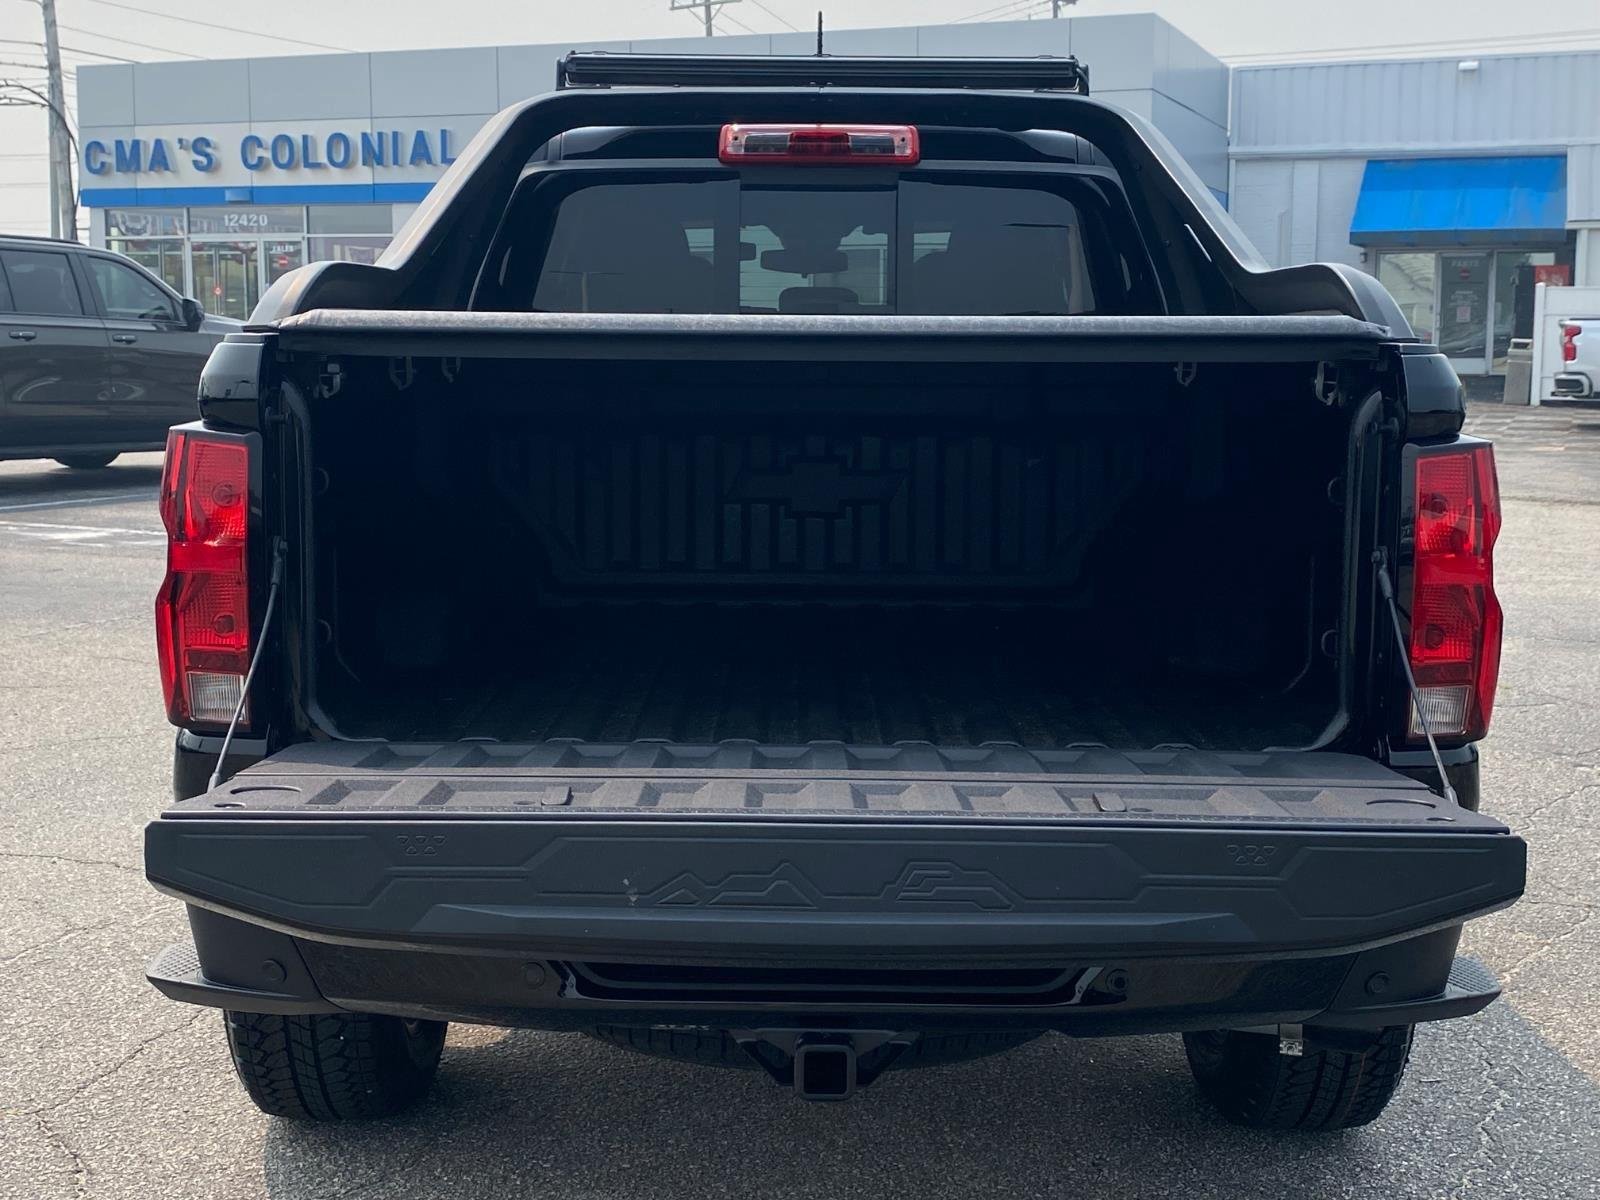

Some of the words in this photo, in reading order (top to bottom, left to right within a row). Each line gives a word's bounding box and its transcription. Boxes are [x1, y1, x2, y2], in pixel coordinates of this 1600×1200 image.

[84, 136, 216, 175] CMA'S
[240, 129, 457, 171] COLONIAL
[223, 214, 268, 227] 12420
